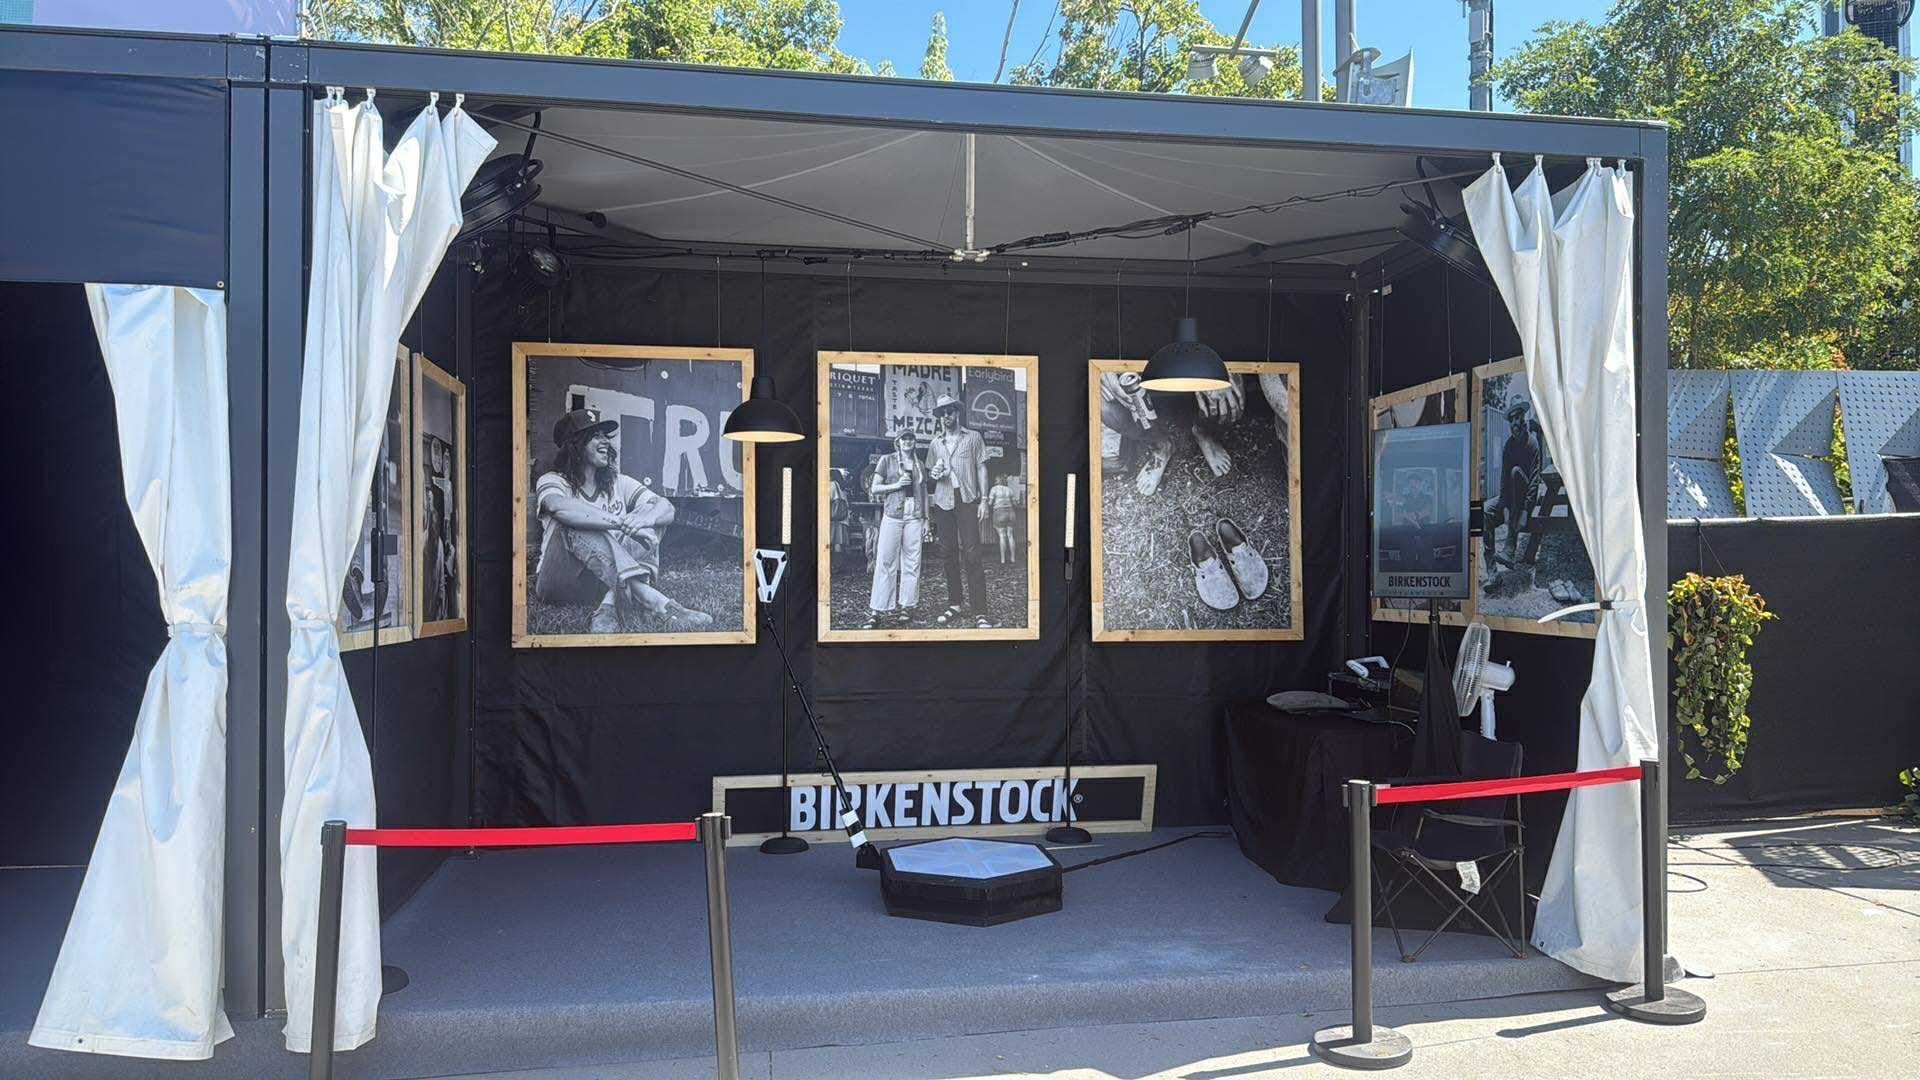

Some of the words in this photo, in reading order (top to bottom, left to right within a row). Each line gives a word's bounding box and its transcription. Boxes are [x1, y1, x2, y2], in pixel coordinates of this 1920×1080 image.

[893, 365, 952, 382] MADRE
[893, 415, 947, 437] MEZCA
[1388, 575, 1451, 588] BIRKENSTOCK
